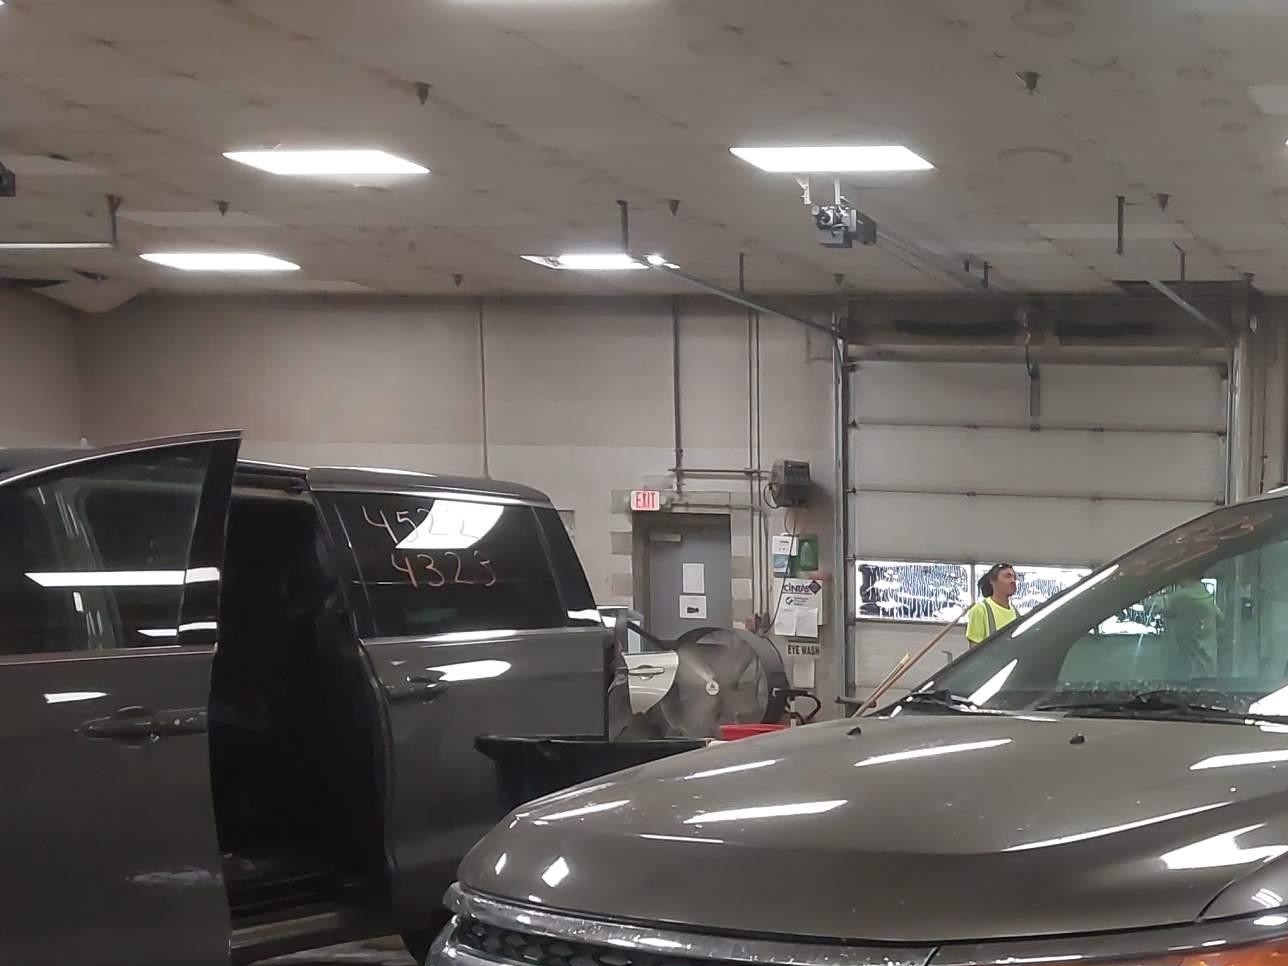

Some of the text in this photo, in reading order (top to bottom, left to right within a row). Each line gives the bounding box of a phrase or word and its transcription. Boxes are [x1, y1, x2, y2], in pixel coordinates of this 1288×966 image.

[635, 492, 656, 509] EXIT
[787, 645, 819, 655] EYE WASH
